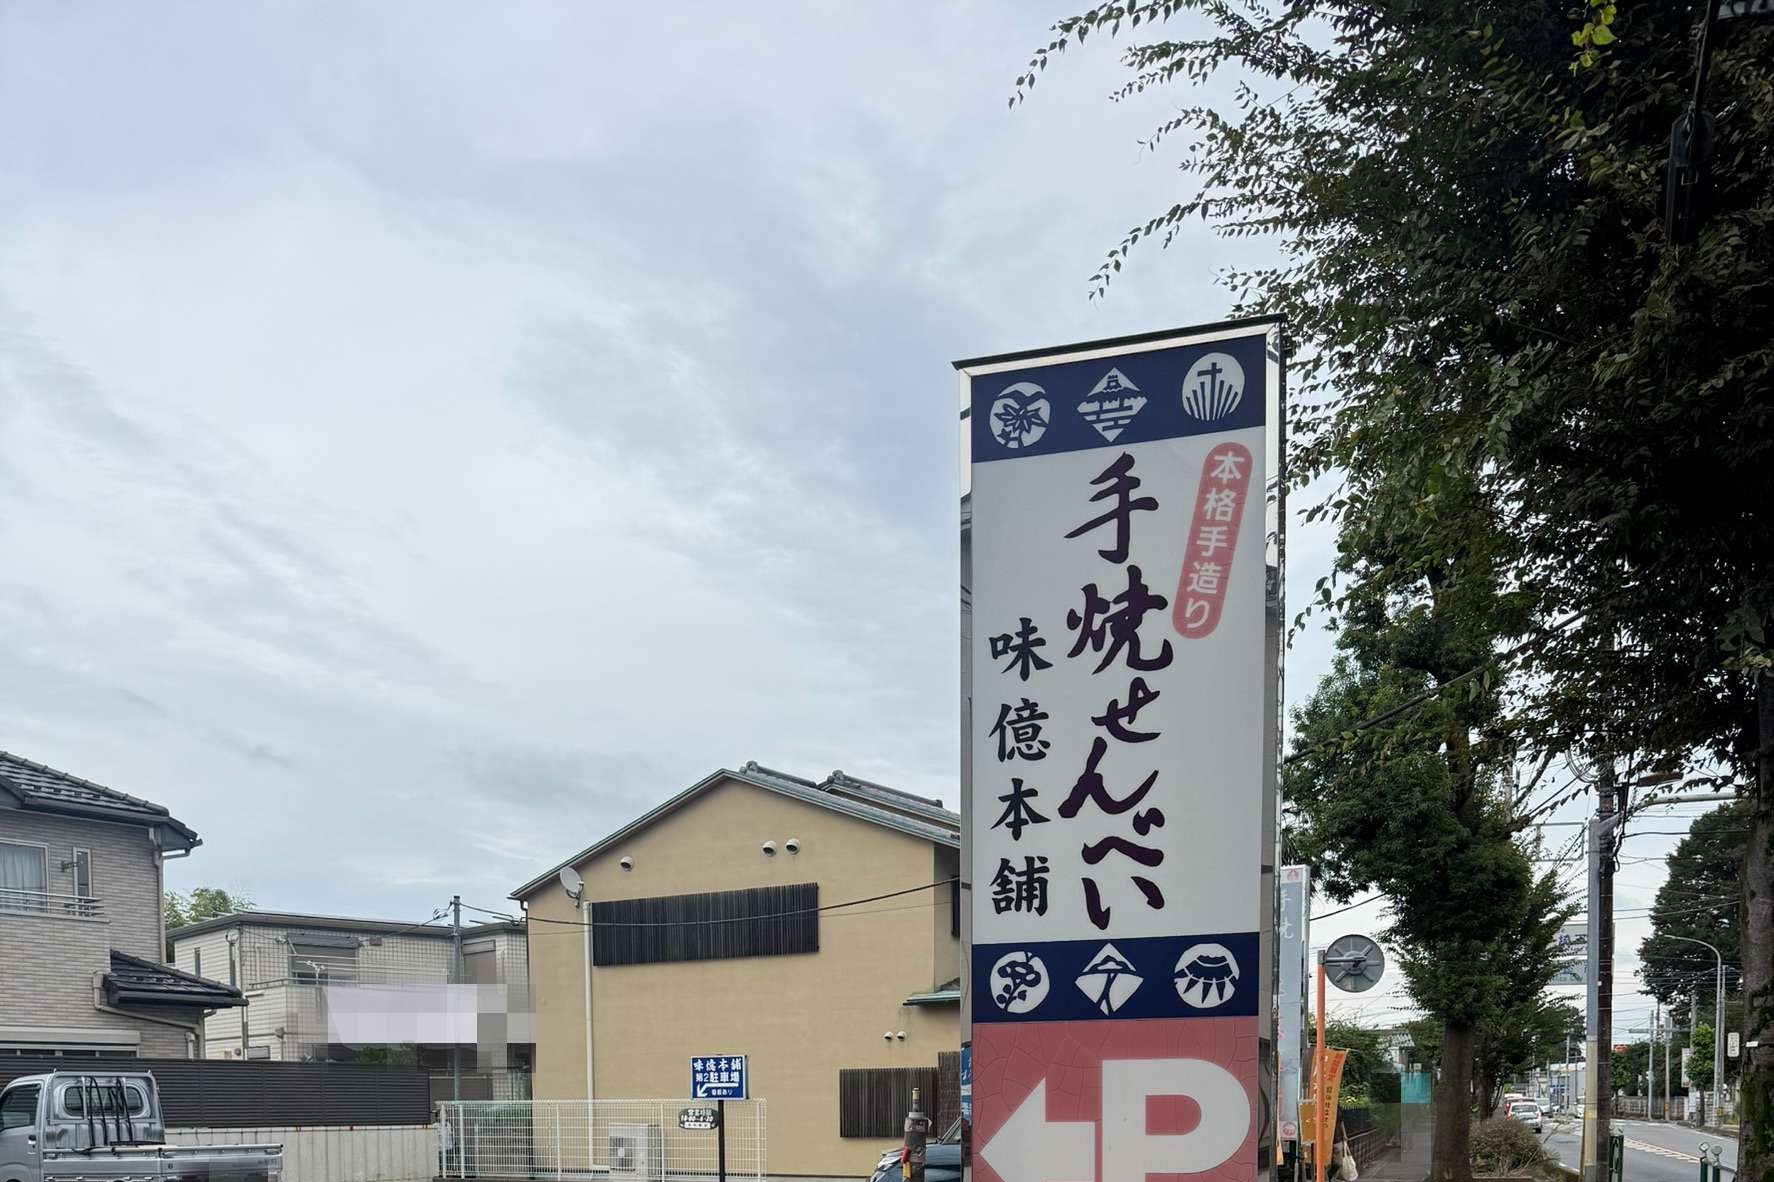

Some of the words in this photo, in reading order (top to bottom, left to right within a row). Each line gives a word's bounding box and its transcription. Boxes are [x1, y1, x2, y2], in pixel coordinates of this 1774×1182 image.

[1184, 451, 1245, 629] 本格手造り
[988, 616, 1054, 917] 味億本舗
[1057, 451, 1174, 931] 手焼せんべい
